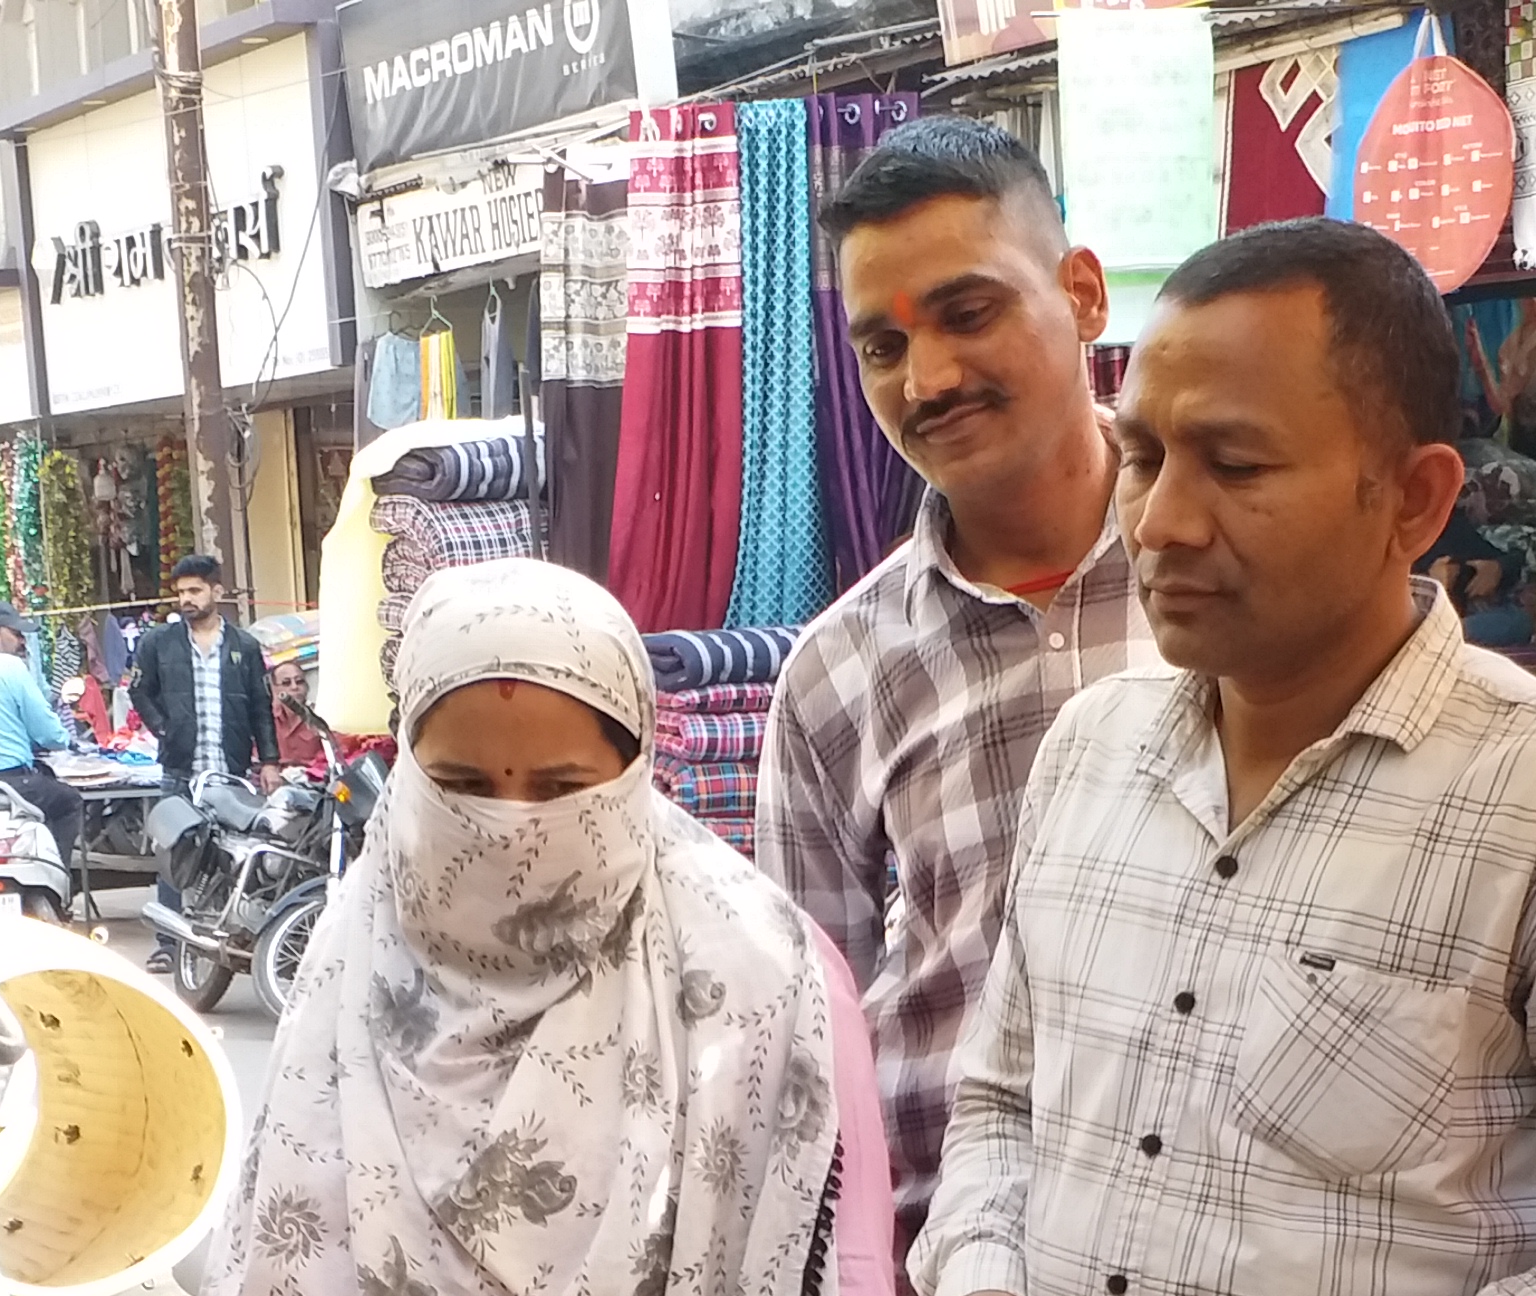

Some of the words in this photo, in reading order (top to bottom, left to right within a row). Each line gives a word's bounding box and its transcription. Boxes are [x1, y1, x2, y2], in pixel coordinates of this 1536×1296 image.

[363, 3, 554, 104] MACROMAN
[481, 164, 518, 195] NEW
[412, 205, 486, 265] KAWAR
